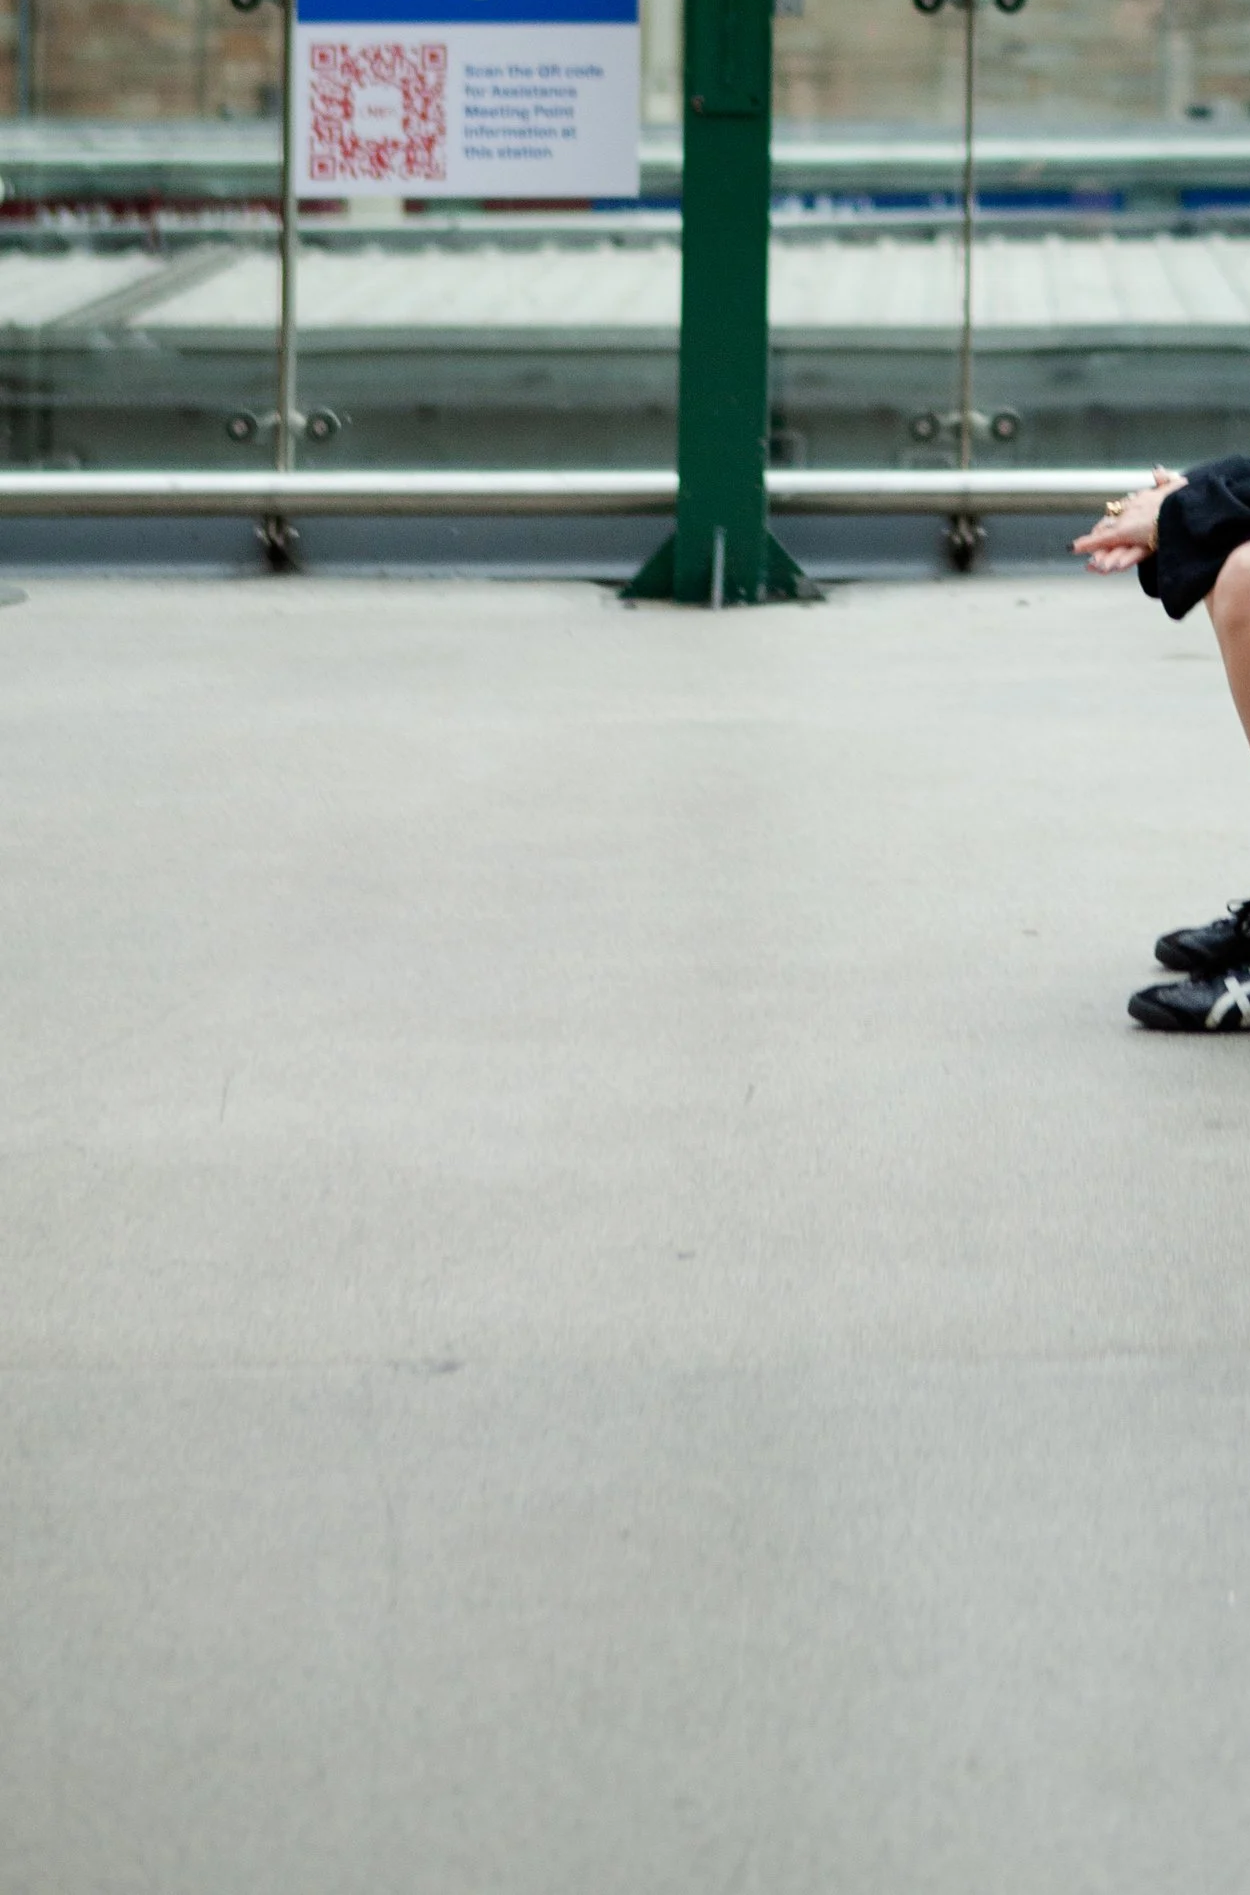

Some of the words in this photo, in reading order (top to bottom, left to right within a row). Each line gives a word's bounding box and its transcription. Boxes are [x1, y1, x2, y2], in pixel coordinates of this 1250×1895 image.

[508, 64, 533, 78] the
[565, 64, 604, 78] code
[492, 85, 577, 98] Assistance
[464, 105, 530, 120] Meeting
[534, 105, 574, 118] Point
